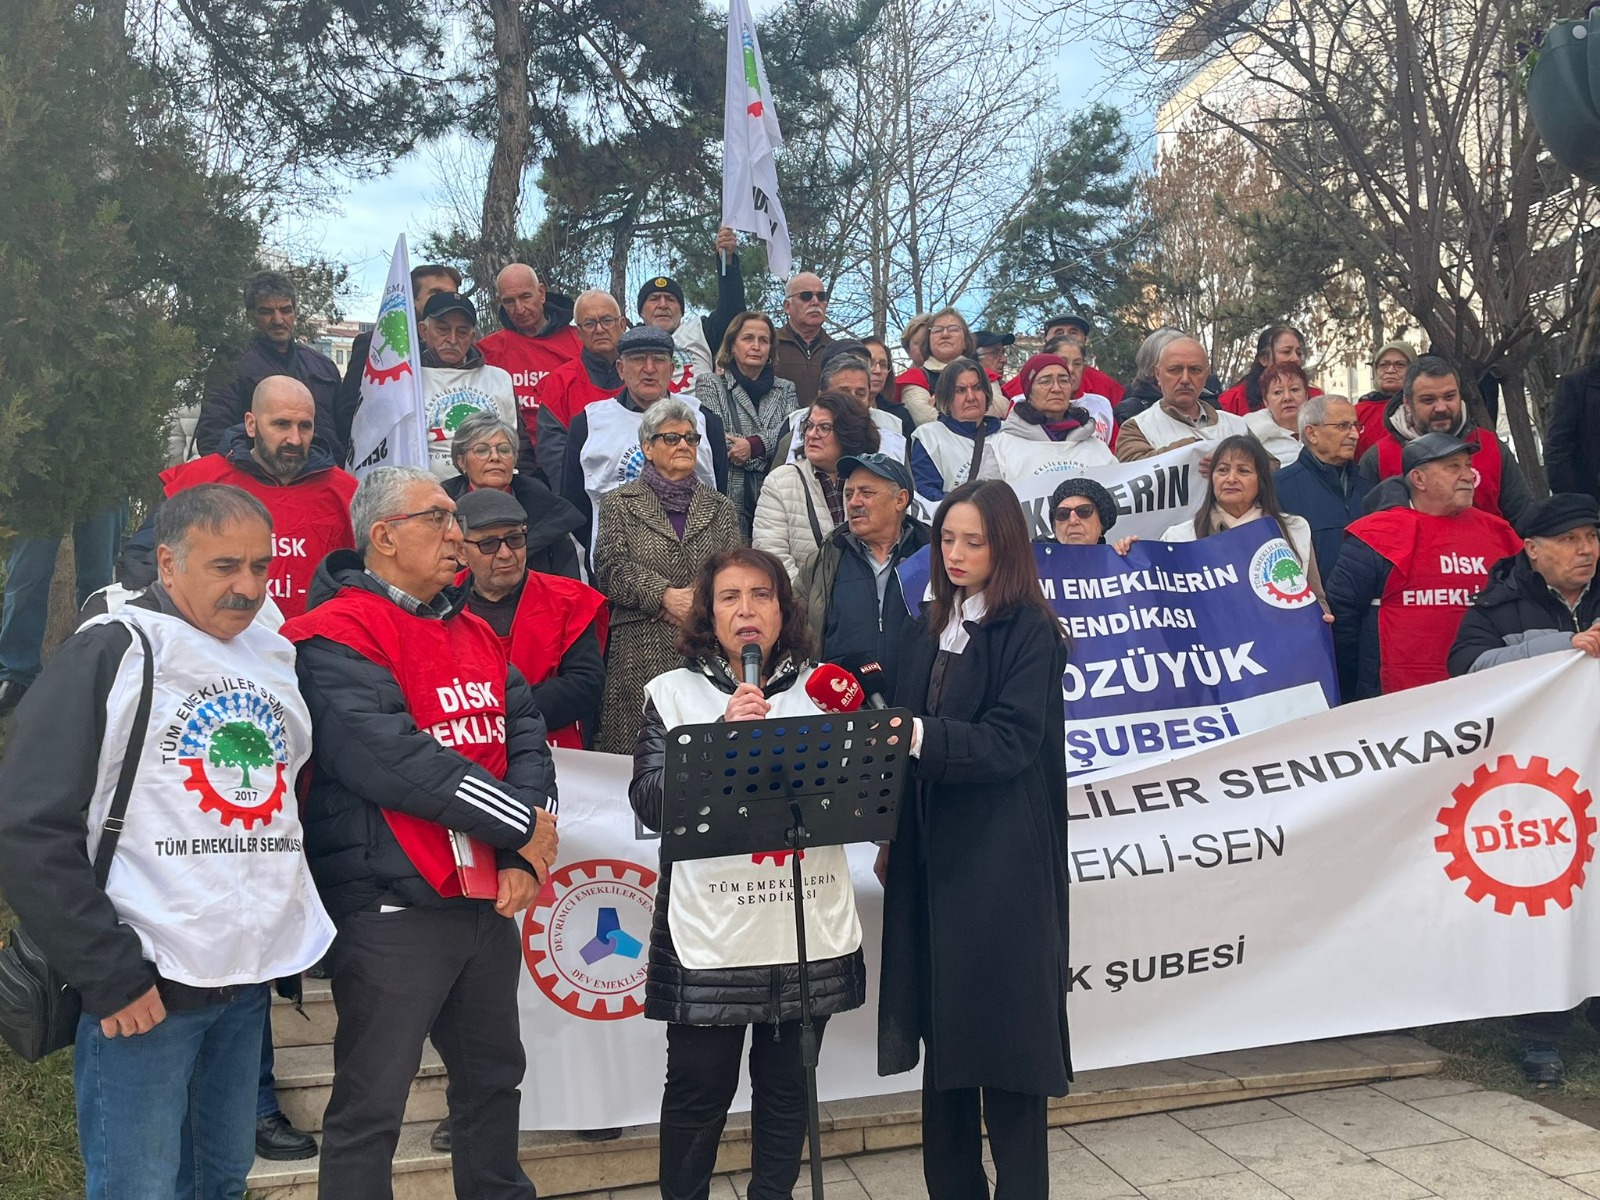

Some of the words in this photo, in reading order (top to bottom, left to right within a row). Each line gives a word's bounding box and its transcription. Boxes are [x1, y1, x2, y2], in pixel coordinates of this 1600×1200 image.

[1440, 552, 1488, 575] DİSK
[1062, 564, 1239, 600] EMEKLİLERİN
[1057, 605, 1197, 638] SENDİKASI
[1062, 640, 1268, 701] OZÜYÜK
[436, 677, 500, 713] DİSK
[160, 725, 182, 764] TÜM
[176, 677, 257, 721] EMEKLİLER
[422, 713, 506, 748] EKLİ-S
[1066, 706, 1241, 767] ŞUBESİ
[1219, 717, 1495, 799] SENDİKASI
[234, 790, 258, 801] 2017
[155, 837, 187, 856] TÜM
[192, 834, 258, 854] EMEKLİLER
[1471, 809, 1571, 853] DİSK
[1068, 825, 1285, 884] EKLİ-SEN
[709, 881, 740, 893] TÜM
[747, 873, 836, 892] EMEKLLERİN
[554, 898, 576, 952] DEVRİMCİ
[575, 885, 636, 902] EMEKLİLER
[571, 968, 593, 985] DEV
[1105, 934, 1245, 993] ŞUBESİ
